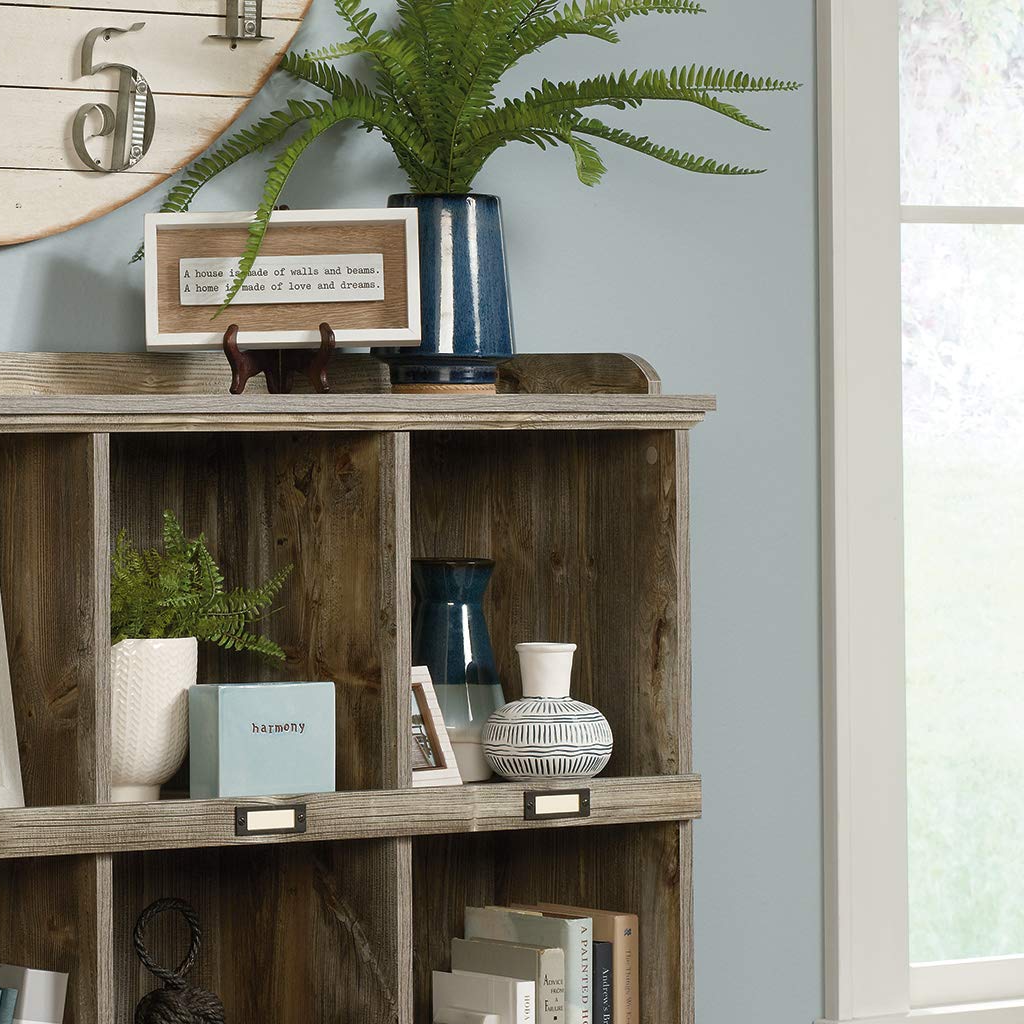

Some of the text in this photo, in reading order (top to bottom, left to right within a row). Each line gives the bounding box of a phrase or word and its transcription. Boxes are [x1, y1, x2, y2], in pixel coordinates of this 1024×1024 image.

[72, 22, 157, 174] 5
[183, 270, 190, 278] A
[195, 269, 224, 278] house
[273, 267, 286, 277] of
[290, 267, 319, 276] walls
[324, 266, 342, 275] and
[346, 266, 380, 275] beams.
[183, 284, 190, 292] A
[195, 284, 219, 292] home
[241, 282, 266, 291] made
[270, 282, 284, 291] of
[288, 281, 312, 290] love
[317, 280, 336, 290] and
[340, 280, 380, 290] dreams.
[251, 722, 305, 734] harmony
[579, 926, 588, 934] A
[581, 939, 589, 1004] PAINTED
[602, 967, 611, 1011] Andrew's
